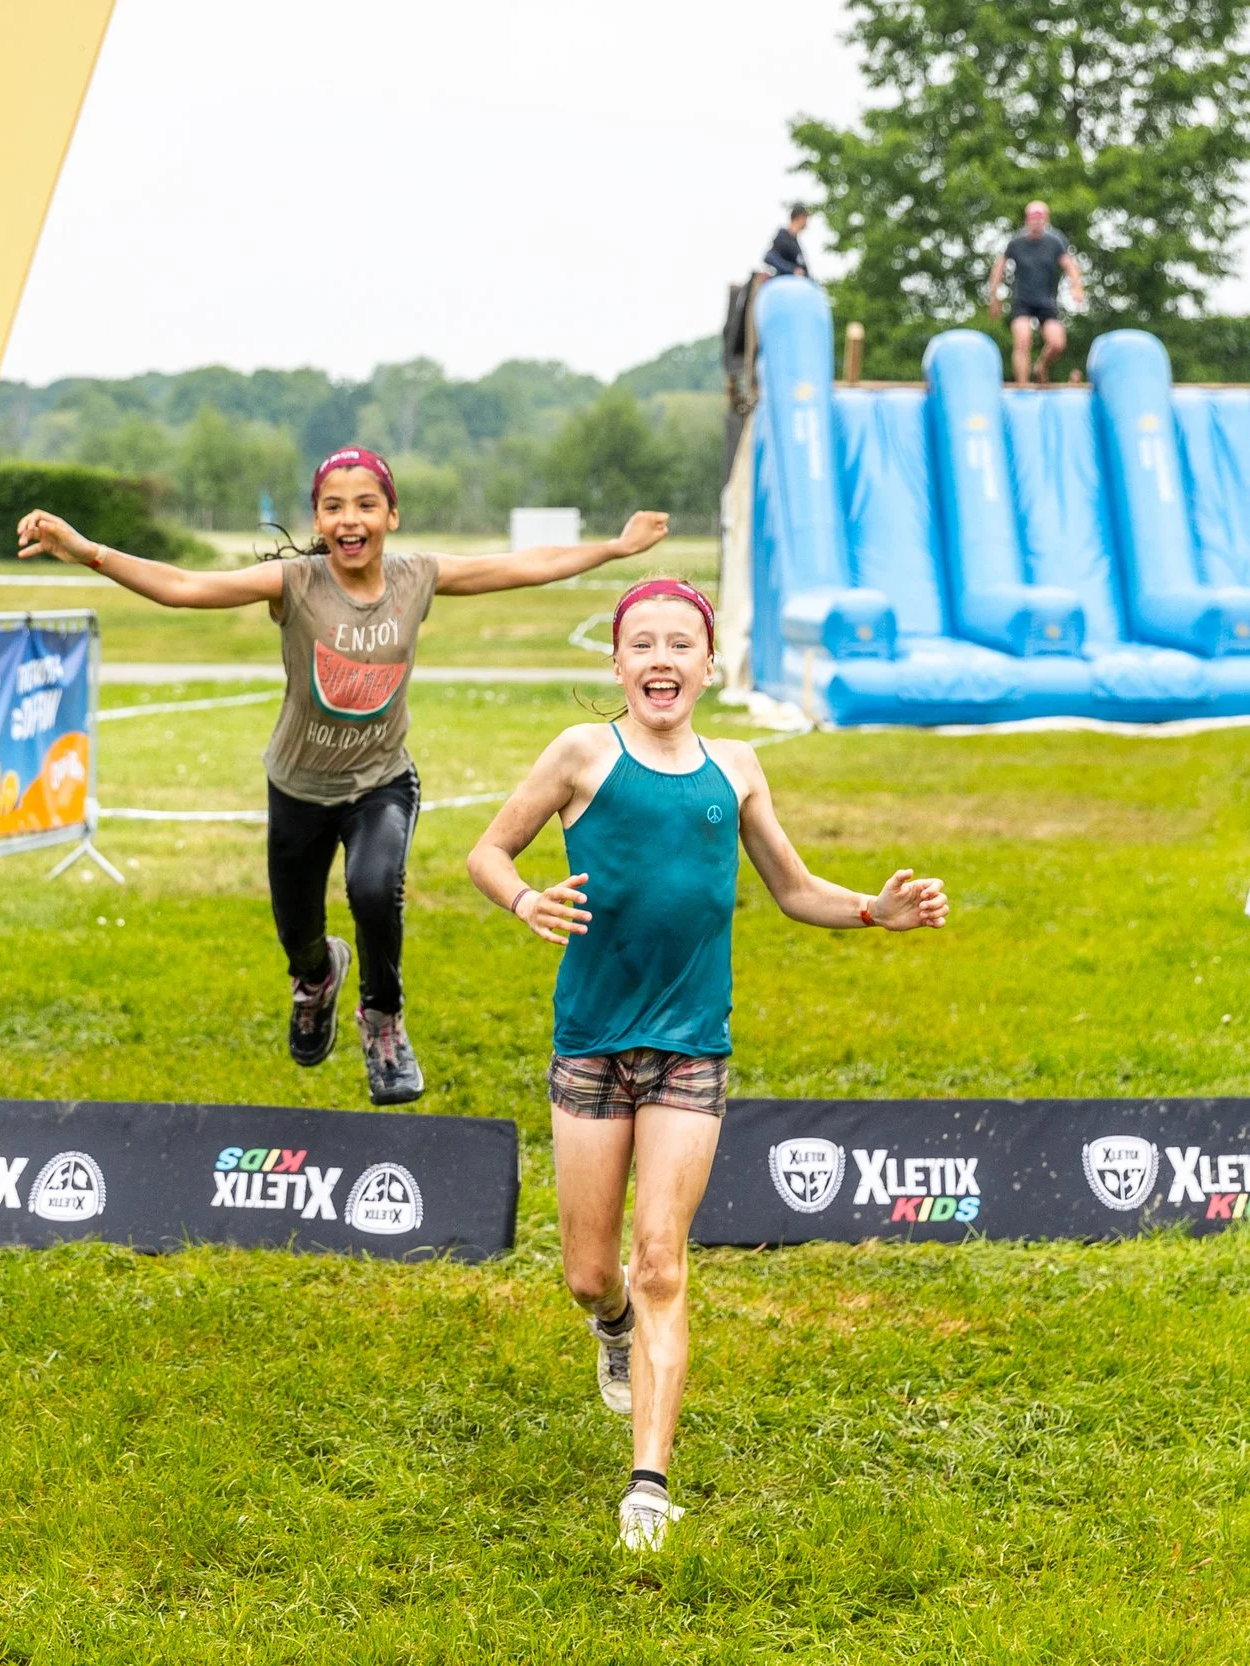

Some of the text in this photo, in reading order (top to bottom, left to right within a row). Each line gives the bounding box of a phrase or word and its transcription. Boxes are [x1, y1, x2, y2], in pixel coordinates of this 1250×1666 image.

[335, 617, 400, 652] ENJOY
[214, 1145, 308, 1173] KIDS
[1164, 1146, 1250, 1203] XLET
[210, 1165, 344, 1220] XLETIX
[851, 1149, 982, 1205] XLETIX
[890, 1196, 982, 1223] KIDS
[1205, 1192, 1250, 1220] KI
